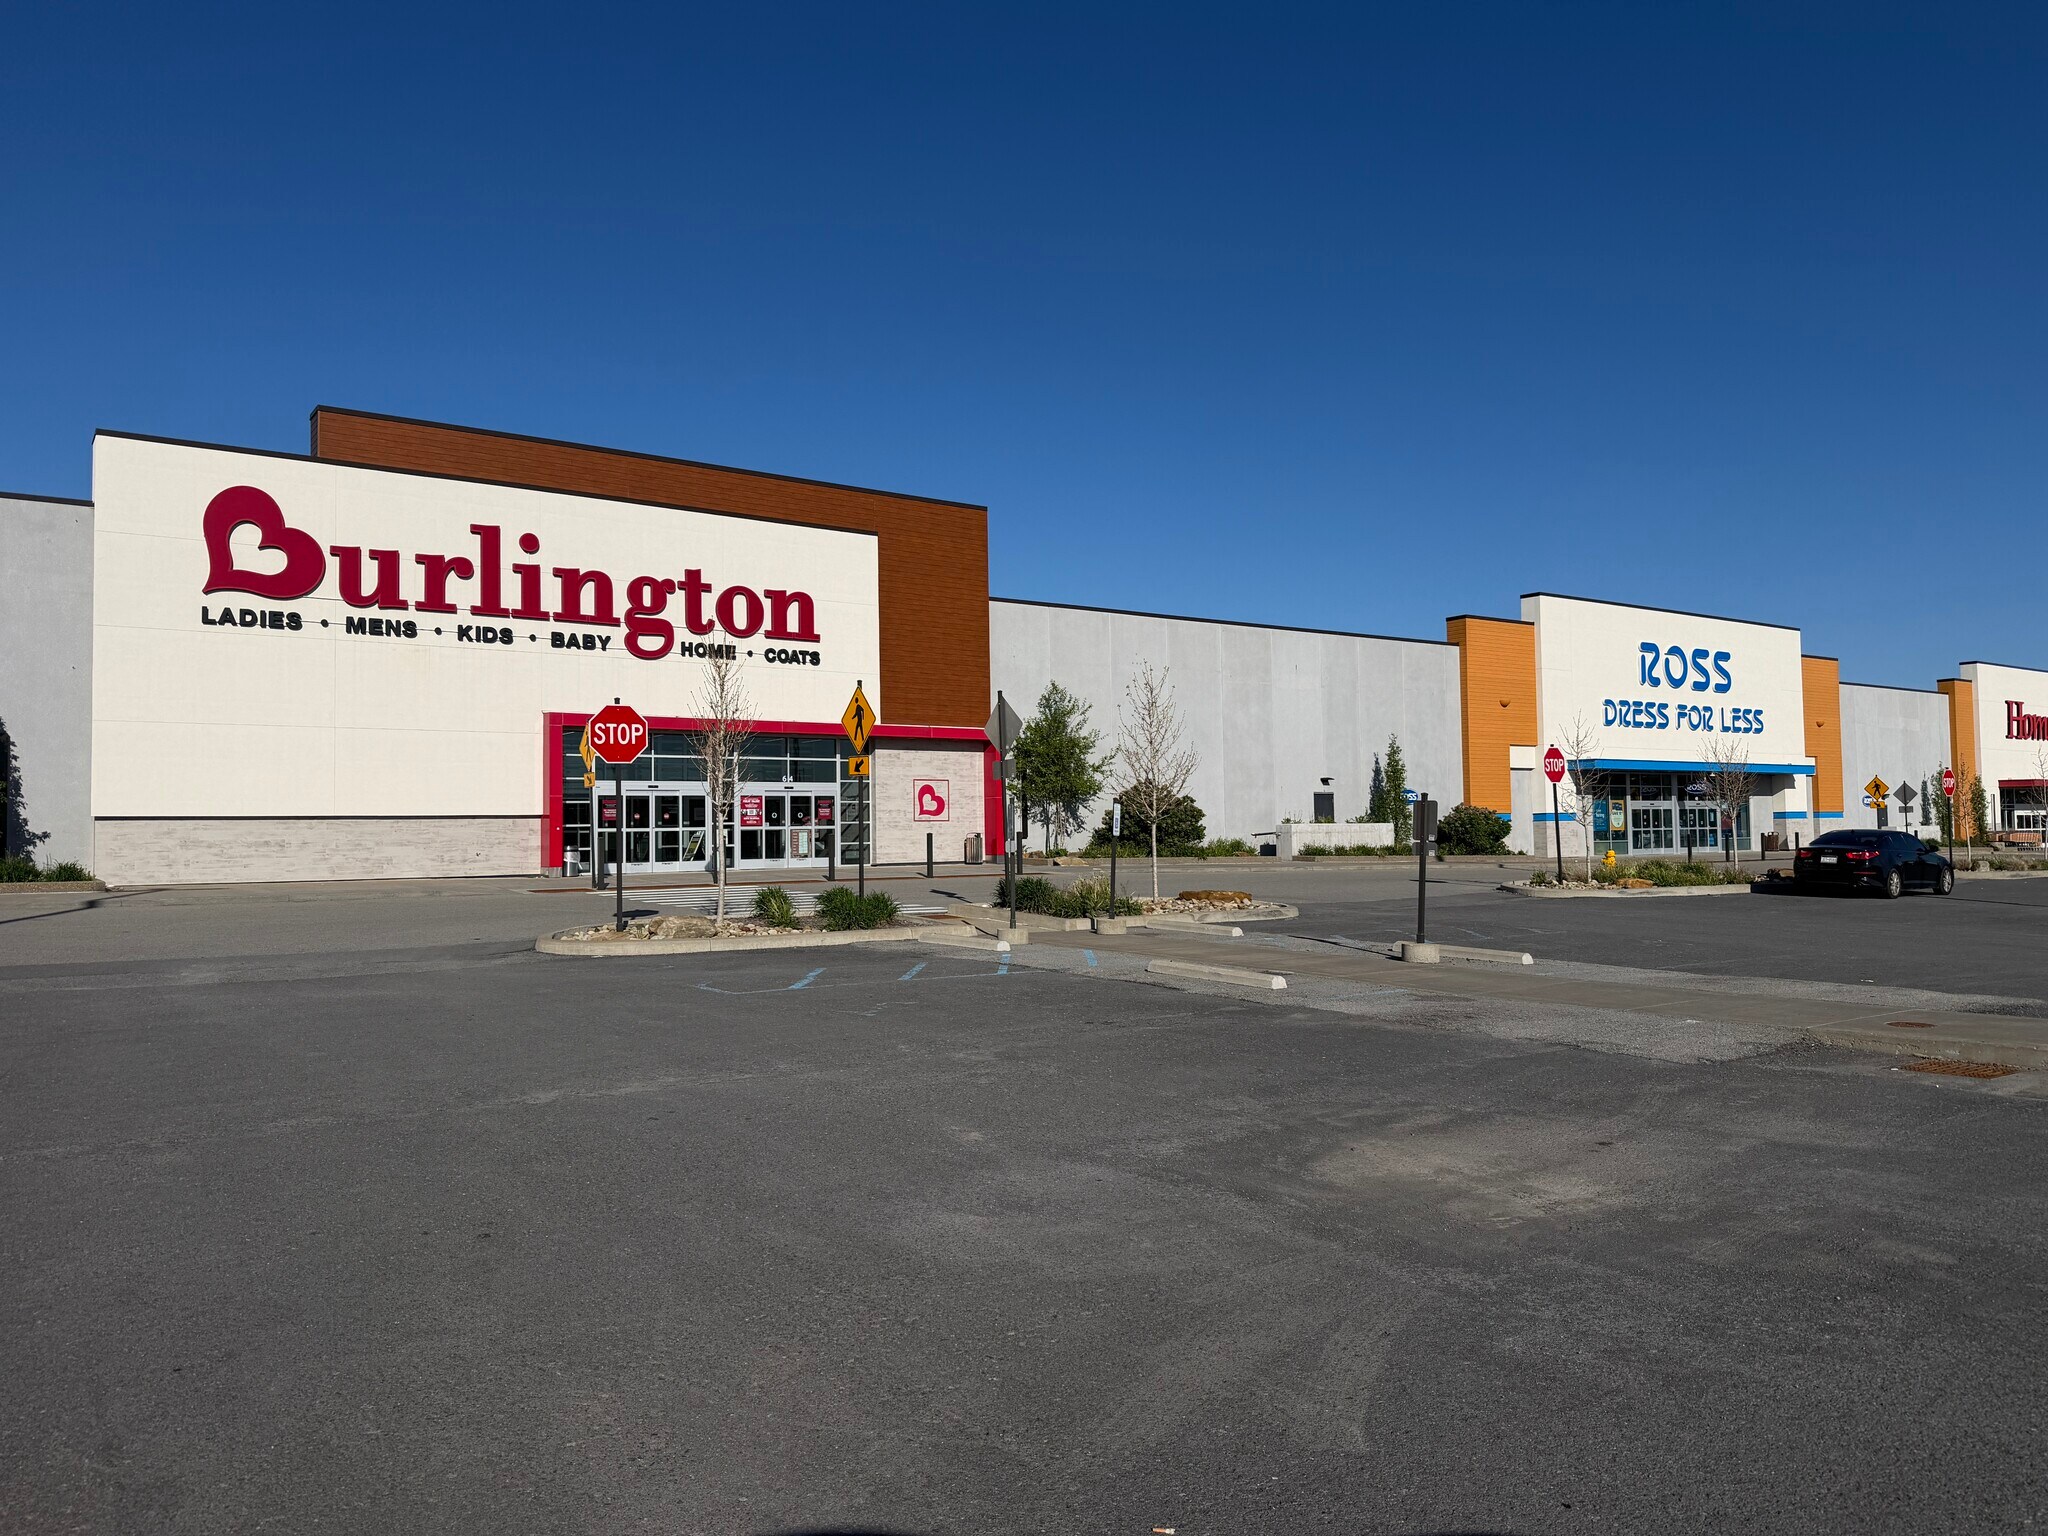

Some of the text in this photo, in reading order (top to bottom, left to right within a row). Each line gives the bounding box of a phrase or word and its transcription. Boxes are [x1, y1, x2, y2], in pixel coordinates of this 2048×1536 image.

[202, 485, 821, 660] Burlington
[201, 605, 821, 667] LADIES MENS KIDS BABY HOME COATS
[1638, 641, 1732, 694] ROSS
[593, 722, 644, 745] STOP
[1603, 699, 1765, 734] DRESS FOR LESS
[1545, 758, 1564, 772] STOP
[1943, 777, 1954, 788] STOP
